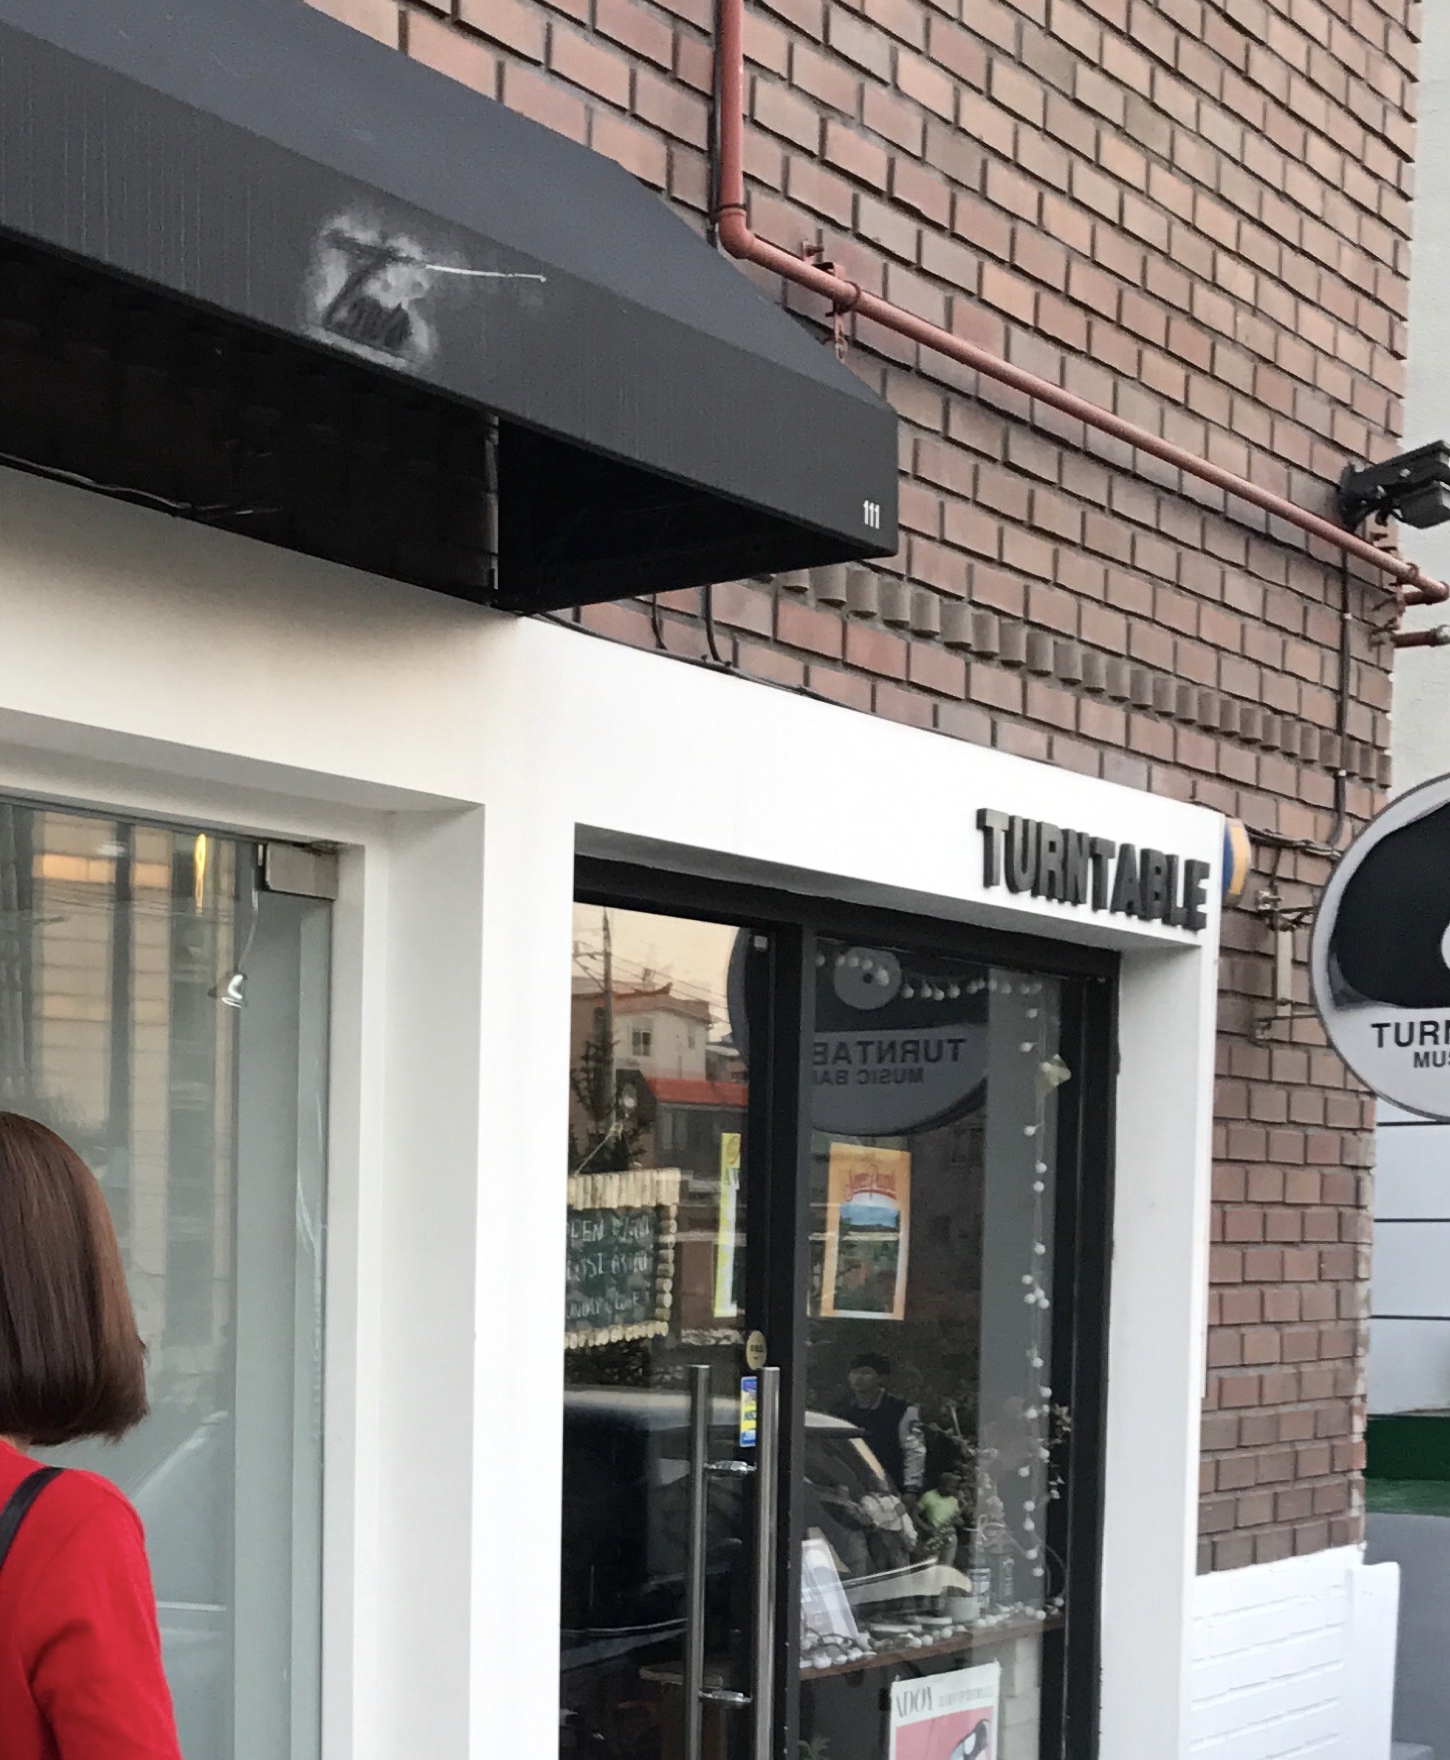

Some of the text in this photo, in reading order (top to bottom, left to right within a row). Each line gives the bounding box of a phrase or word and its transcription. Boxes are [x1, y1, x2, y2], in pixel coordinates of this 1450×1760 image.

[863, 499, 880, 530] 111
[976, 807, 1211, 934] TURNTABLE
[1371, 1020, 1450, 1049] TUR
[1413, 1051, 1450, 1069] MU
